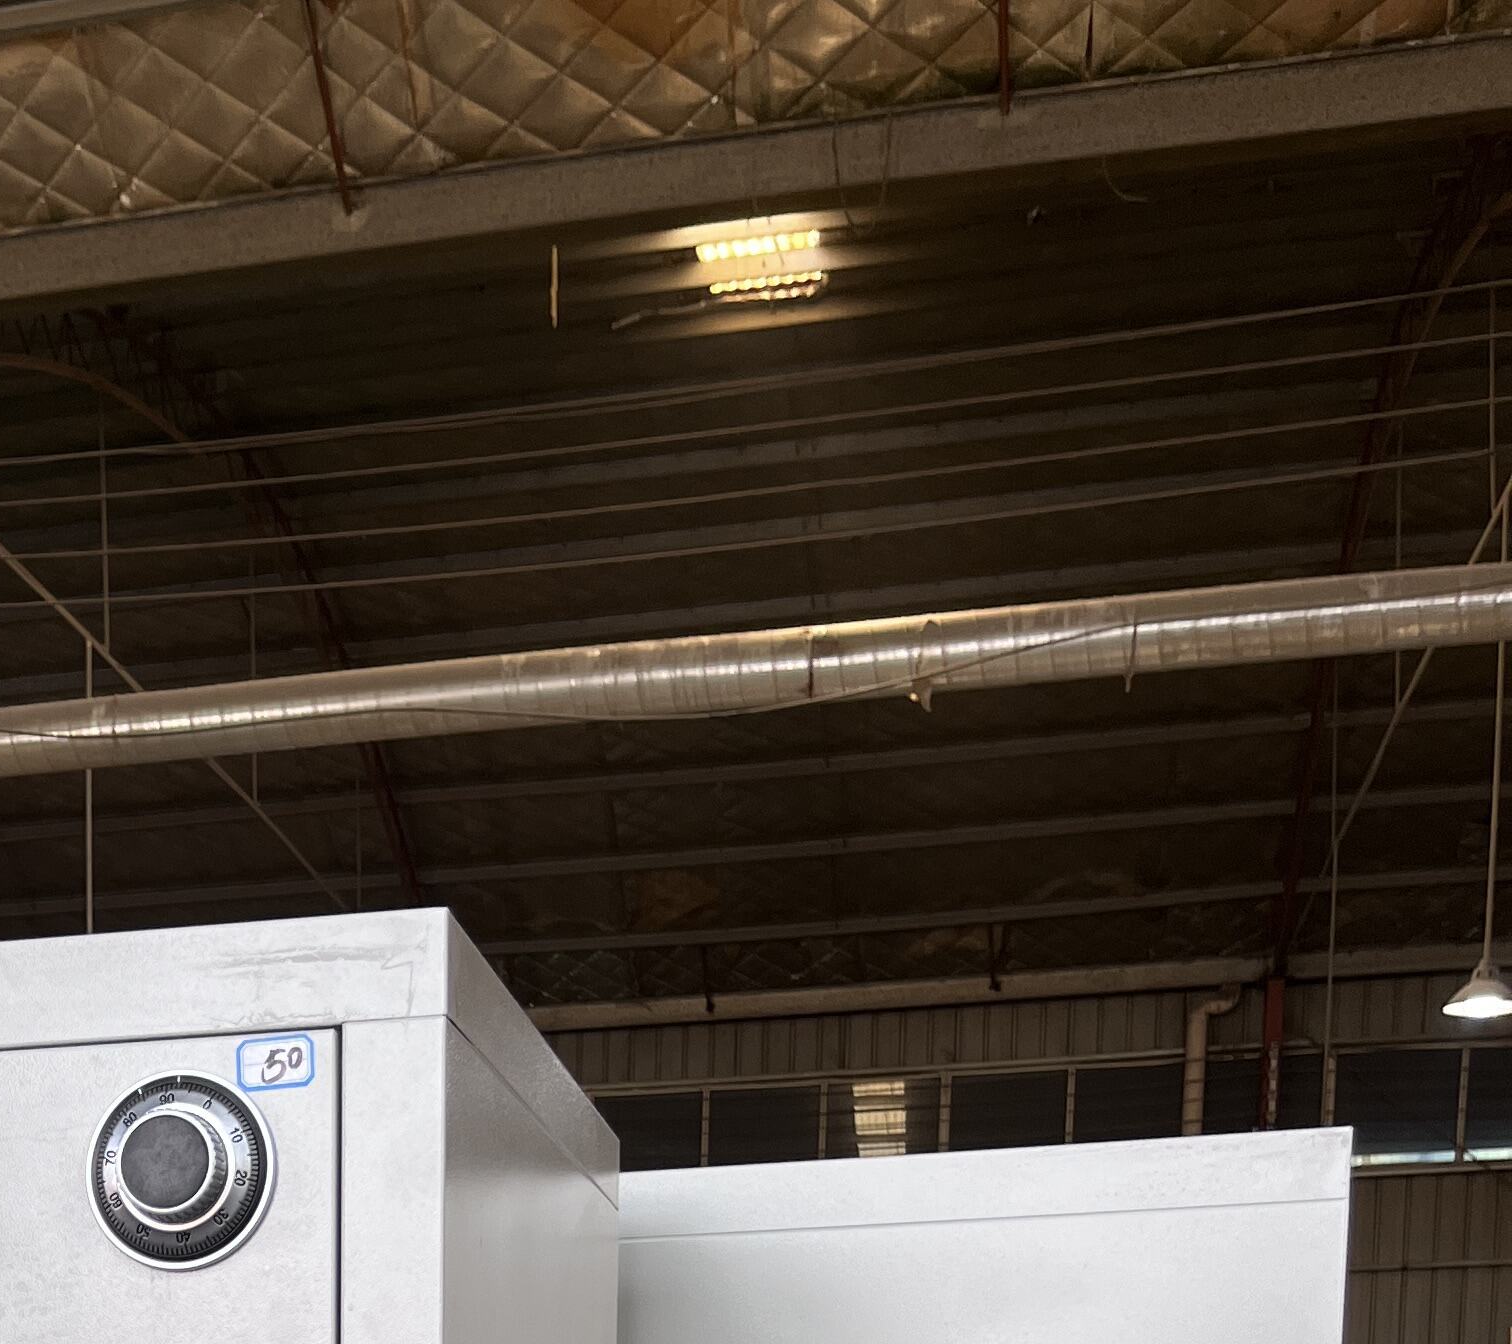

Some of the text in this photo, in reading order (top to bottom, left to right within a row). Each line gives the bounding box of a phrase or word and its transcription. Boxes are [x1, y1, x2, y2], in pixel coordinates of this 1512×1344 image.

[261, 1046, 303, 1085] 50
[159, 1093, 175, 1105] 90
[203, 1100, 212, 1109] 0
[122, 1111, 137, 1127] 80
[230, 1127, 243, 1143] 10
[105, 1150, 117, 1166] 70
[234, 1169, 248, 1187] 20
[109, 1192, 123, 1209] 60
[213, 1208, 229, 1226] 30
[136, 1223, 151, 1239] 50
[176, 1231, 191, 1244] 40
